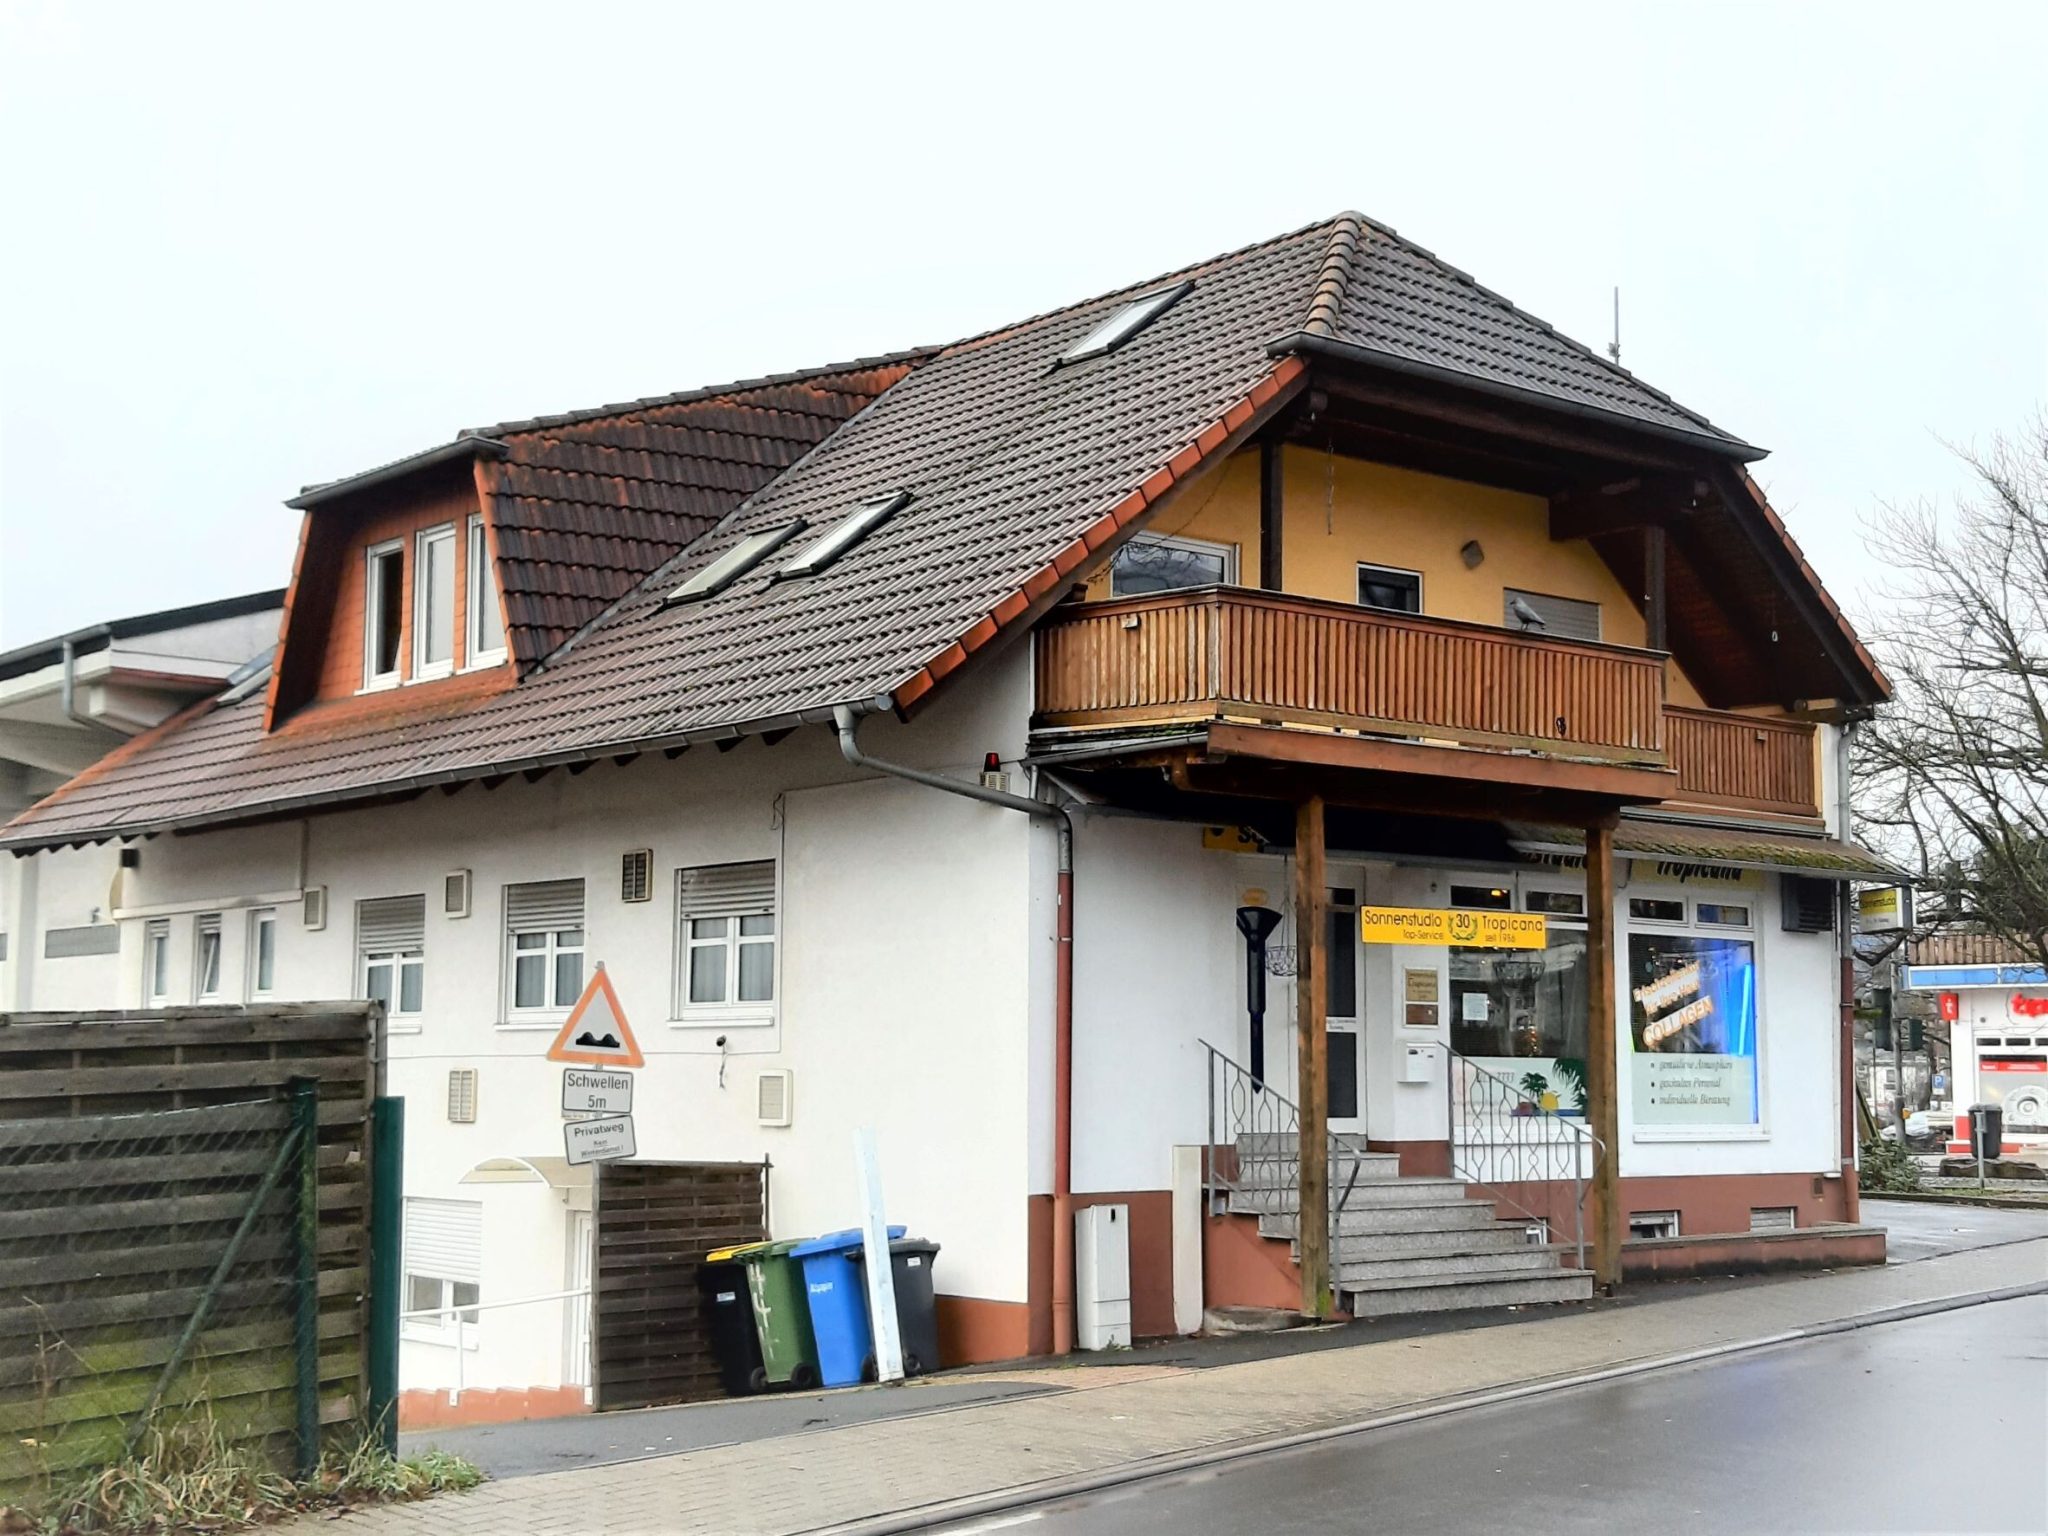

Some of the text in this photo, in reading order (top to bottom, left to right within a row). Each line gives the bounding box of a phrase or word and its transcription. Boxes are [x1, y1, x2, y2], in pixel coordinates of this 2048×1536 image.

[1364, 909, 1543, 932] Sonnenstudio 30 Tropicana
[1403, 929, 1444, 941] Top-Service
[1643, 996, 1713, 1045] COLLAGEN
[567, 1072, 629, 1090] Schwellen
[588, 1094, 607, 1109] 5m
[573, 1123, 625, 1137] Privatweg
